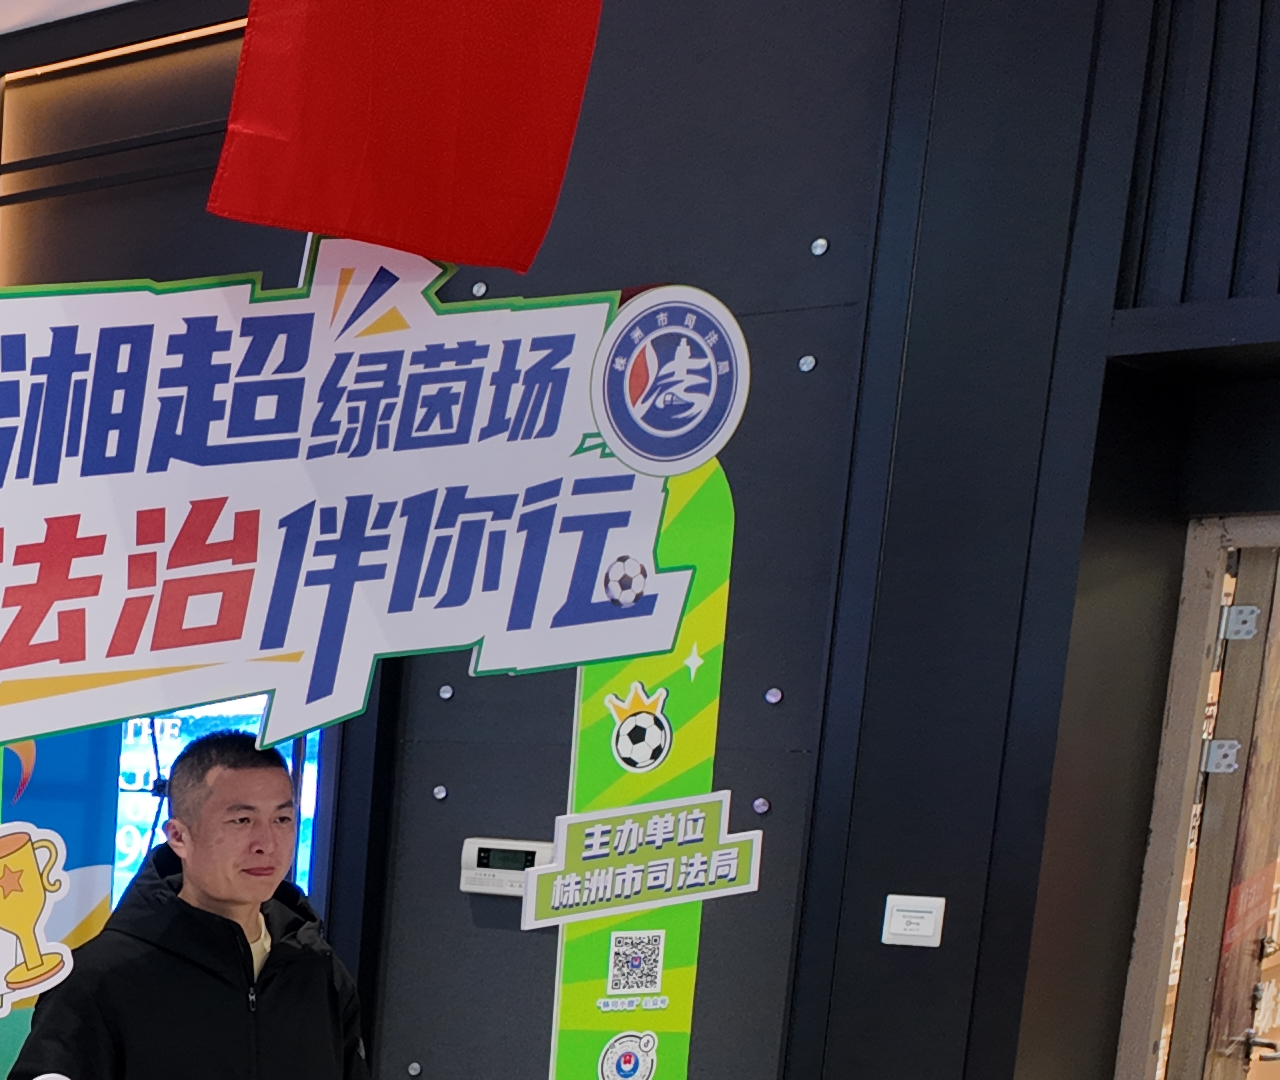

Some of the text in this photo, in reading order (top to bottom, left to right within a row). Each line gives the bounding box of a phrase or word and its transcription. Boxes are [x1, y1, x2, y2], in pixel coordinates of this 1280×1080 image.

[582, 808, 707, 861] 主办单位
[551, 847, 740, 911] 株洲市司法局
